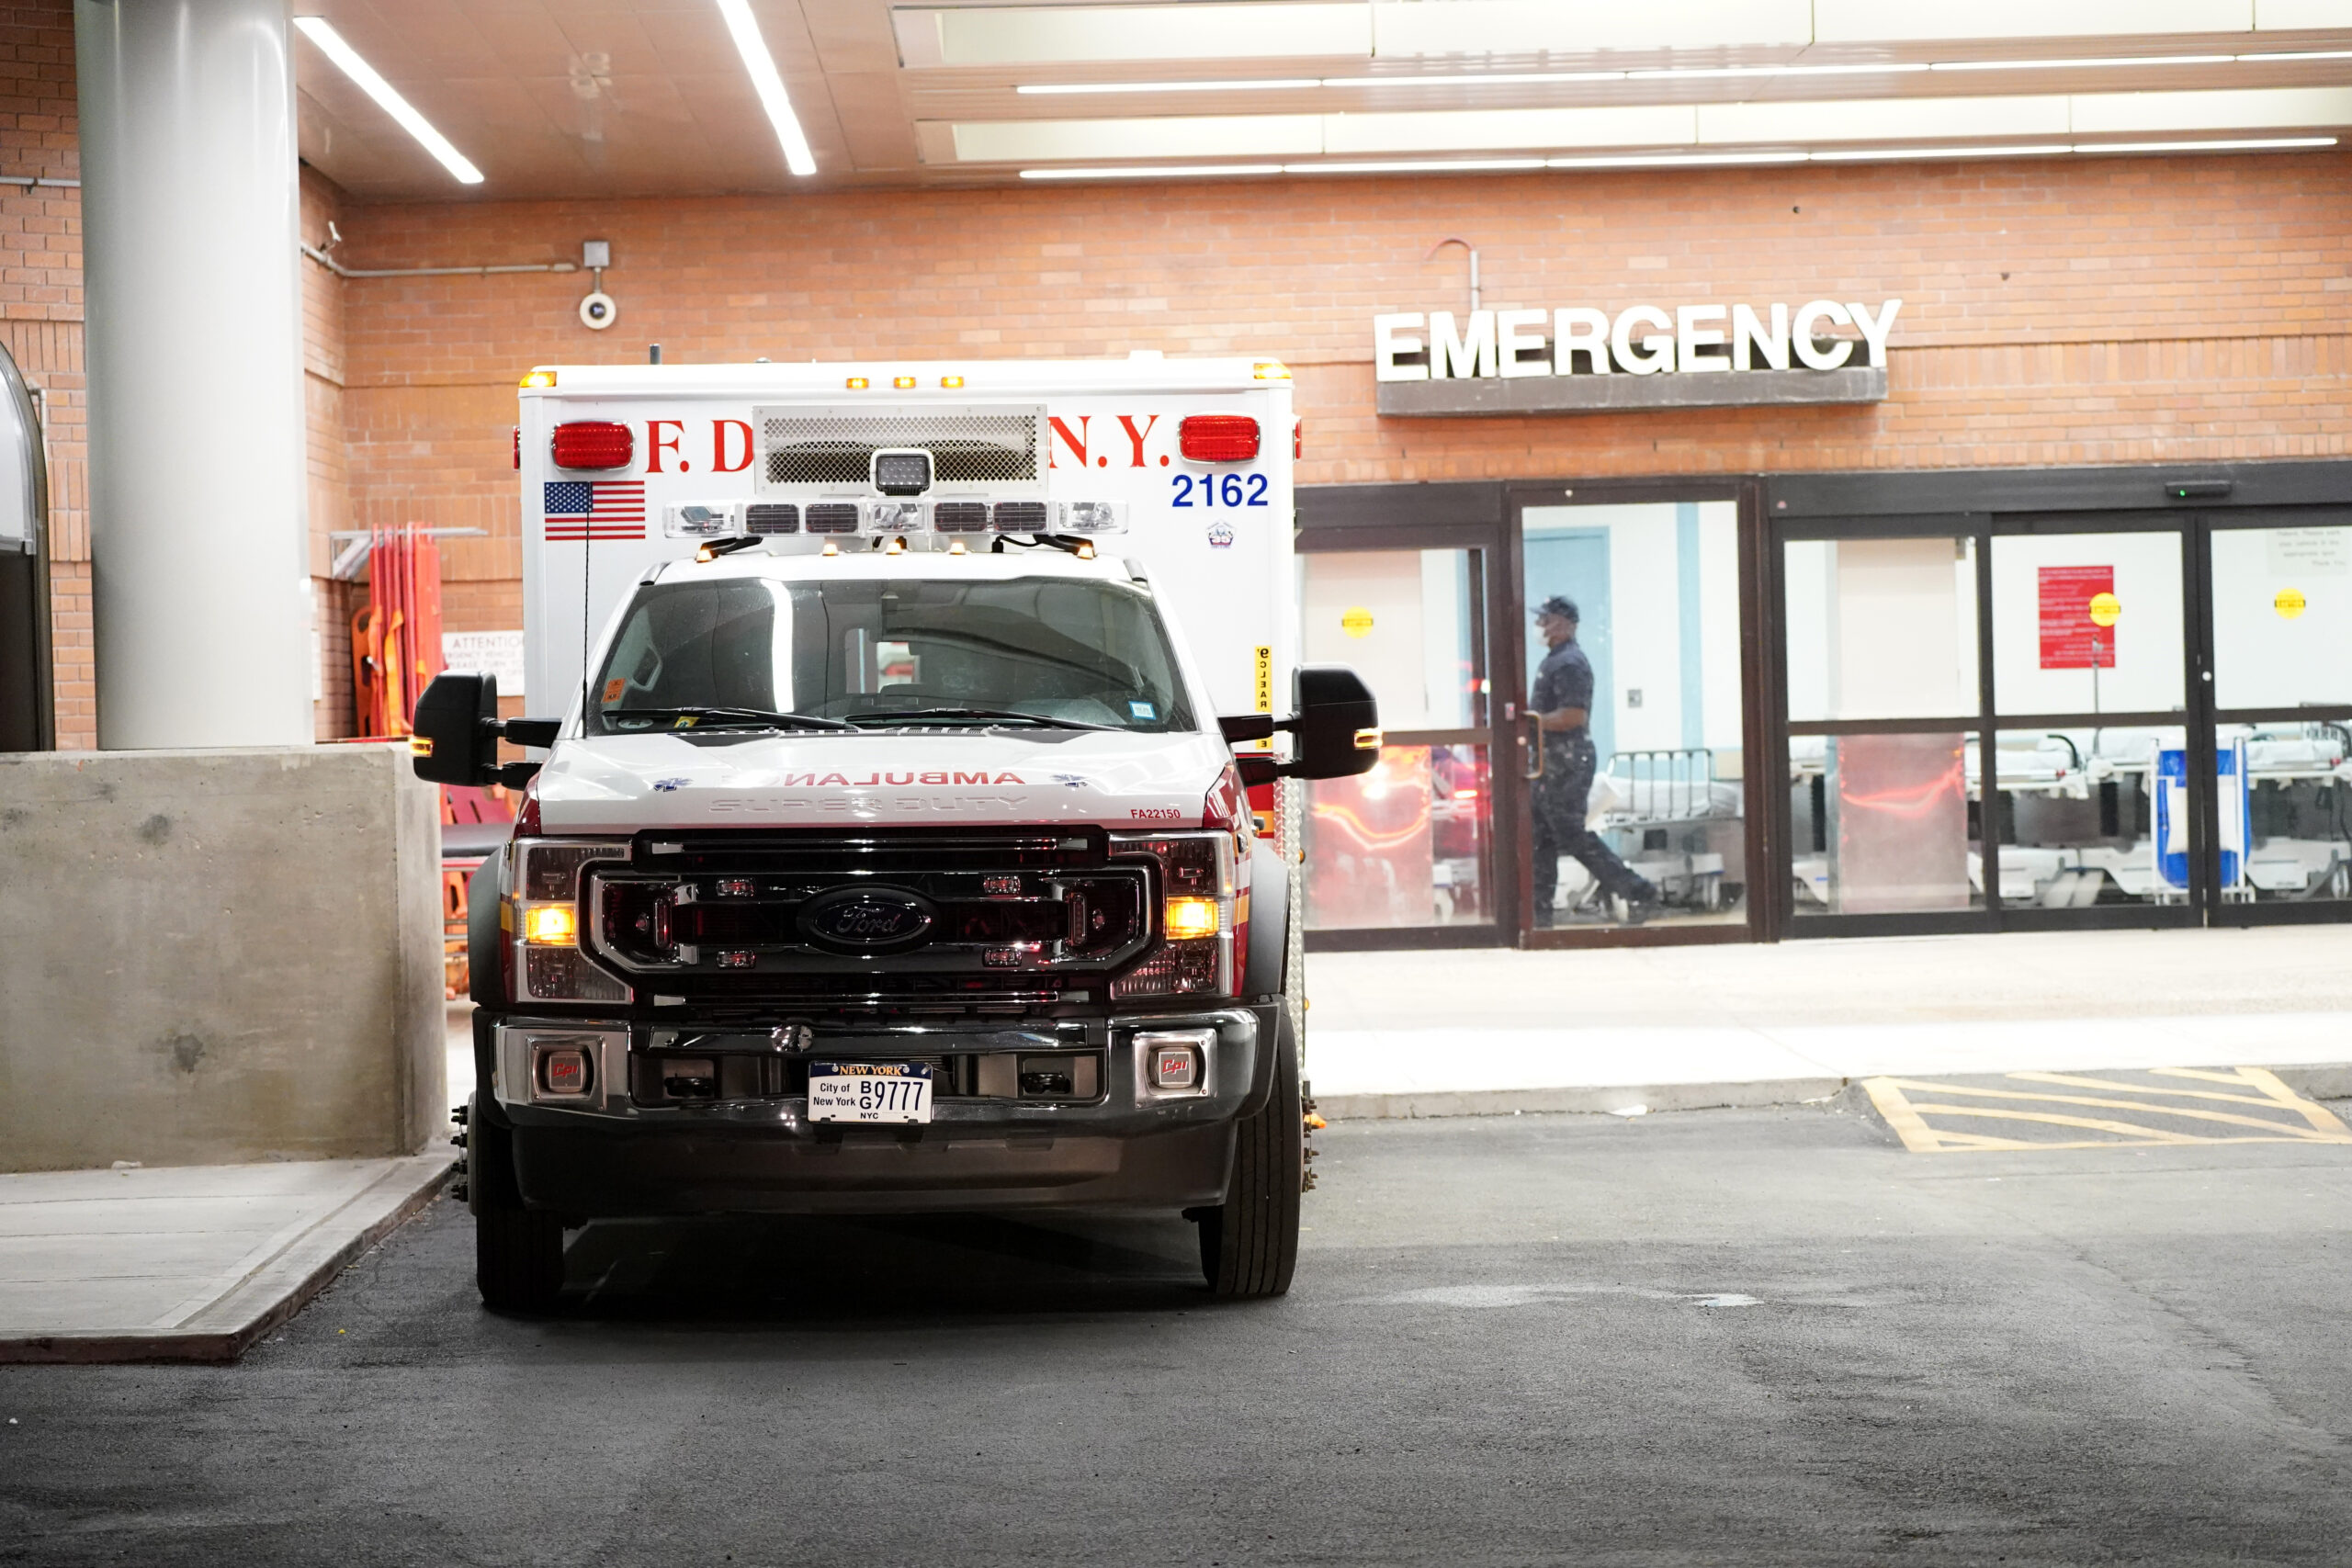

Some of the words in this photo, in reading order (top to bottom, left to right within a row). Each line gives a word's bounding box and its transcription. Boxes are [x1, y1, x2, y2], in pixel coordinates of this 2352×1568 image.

[1374, 299, 1904, 383] EMERGENCY
[1048, 414, 1170, 469] N.Y.
[1171, 473, 1269, 508] 2162
[709, 797, 883, 813] SUPER
[895, 795, 1029, 812] DUTY
[1130, 808, 1181, 819] FA22150
[835, 907, 902, 933] Ford
[840, 1066, 869, 1076] NEW
[872, 1066, 902, 1077] YORK
[820, 1083, 838, 1094] City
[841, 1083, 851, 1092] of
[813, 1097, 833, 1106] New
[836, 1097, 856, 1106] York
